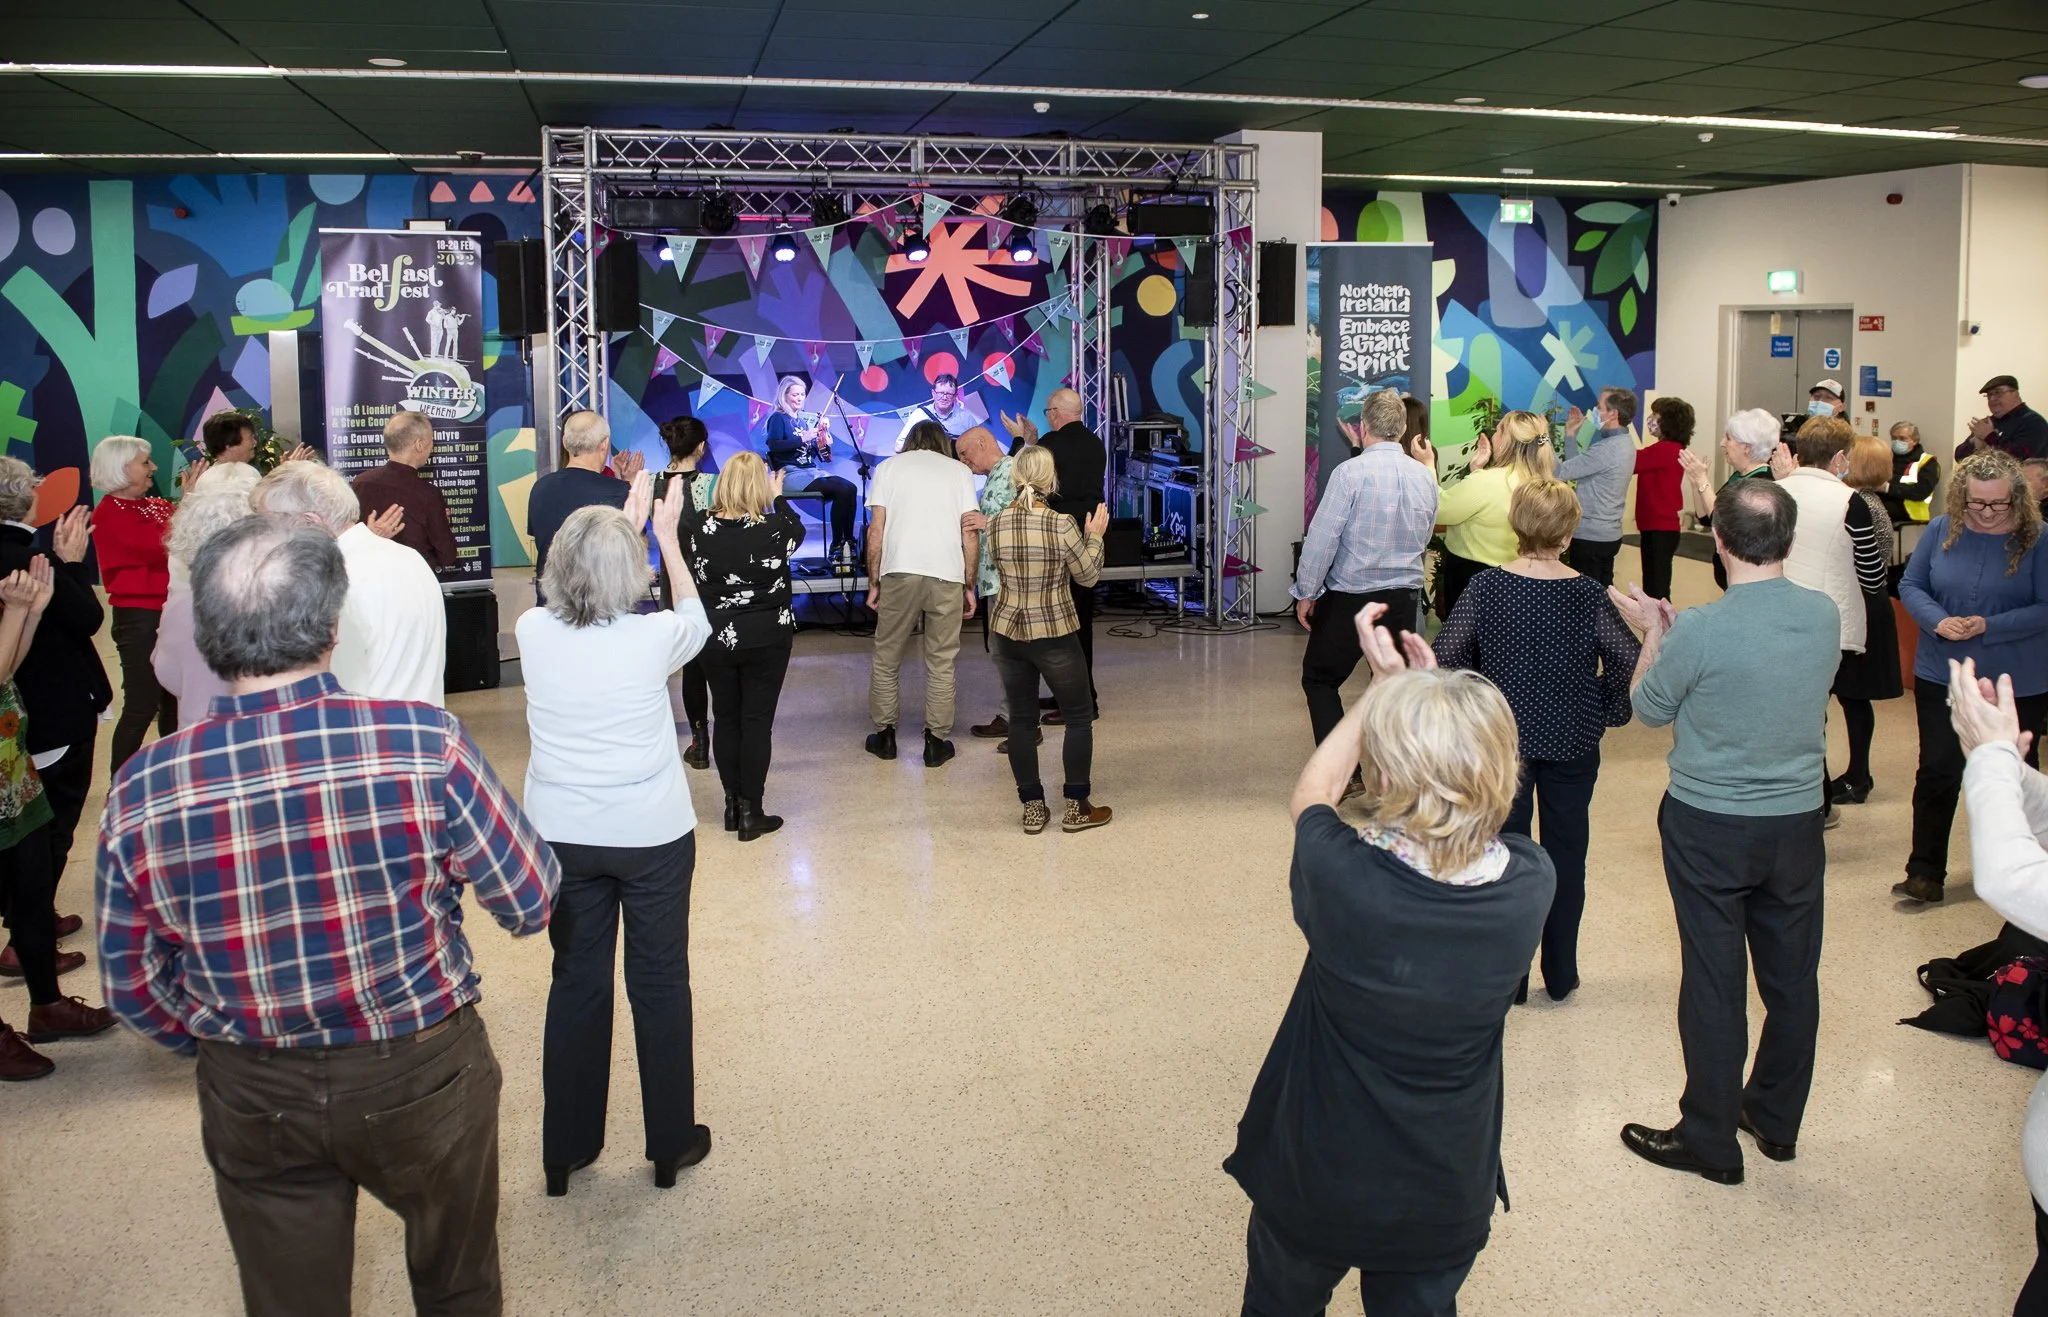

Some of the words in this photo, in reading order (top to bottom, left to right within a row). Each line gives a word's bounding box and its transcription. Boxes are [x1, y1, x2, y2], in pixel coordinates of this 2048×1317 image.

[437, 240, 459, 250] 18-20
[461, 240, 475, 250] FEB
[437, 253, 475, 266] 2022
[1340, 283, 1411, 298] Northern
[1340, 296, 1411, 313] Ireland
[1339, 318, 1410, 336] Embrace
[1340, 335, 1353, 350] a
[1353, 333, 1412, 353] Giant
[1338, 349, 1411, 378] Spirit
[405, 386, 477, 401] WINTER
[362, 404, 397, 415] Lionáird
[420, 403, 456, 419] WEEKEND
[341, 417, 366, 428] Steve
[333, 434, 349, 445] Zoe
[350, 433, 384, 444] Conway
[432, 430, 460, 441] Intyre
[357, 448, 362, 456] &
[364, 448, 386, 456] Stevie
[431, 444, 453, 453] eamie
[455, 443, 479, 452] O'Dowd
[466, 455, 479, 463] TRIP
[459, 469, 480, 477] Cannon
[457, 478, 476, 487] Hogan
[460, 487, 478, 496] Smyth
[447, 497, 474, 506] McKenna
[460, 524, 486, 533] Eastwood
